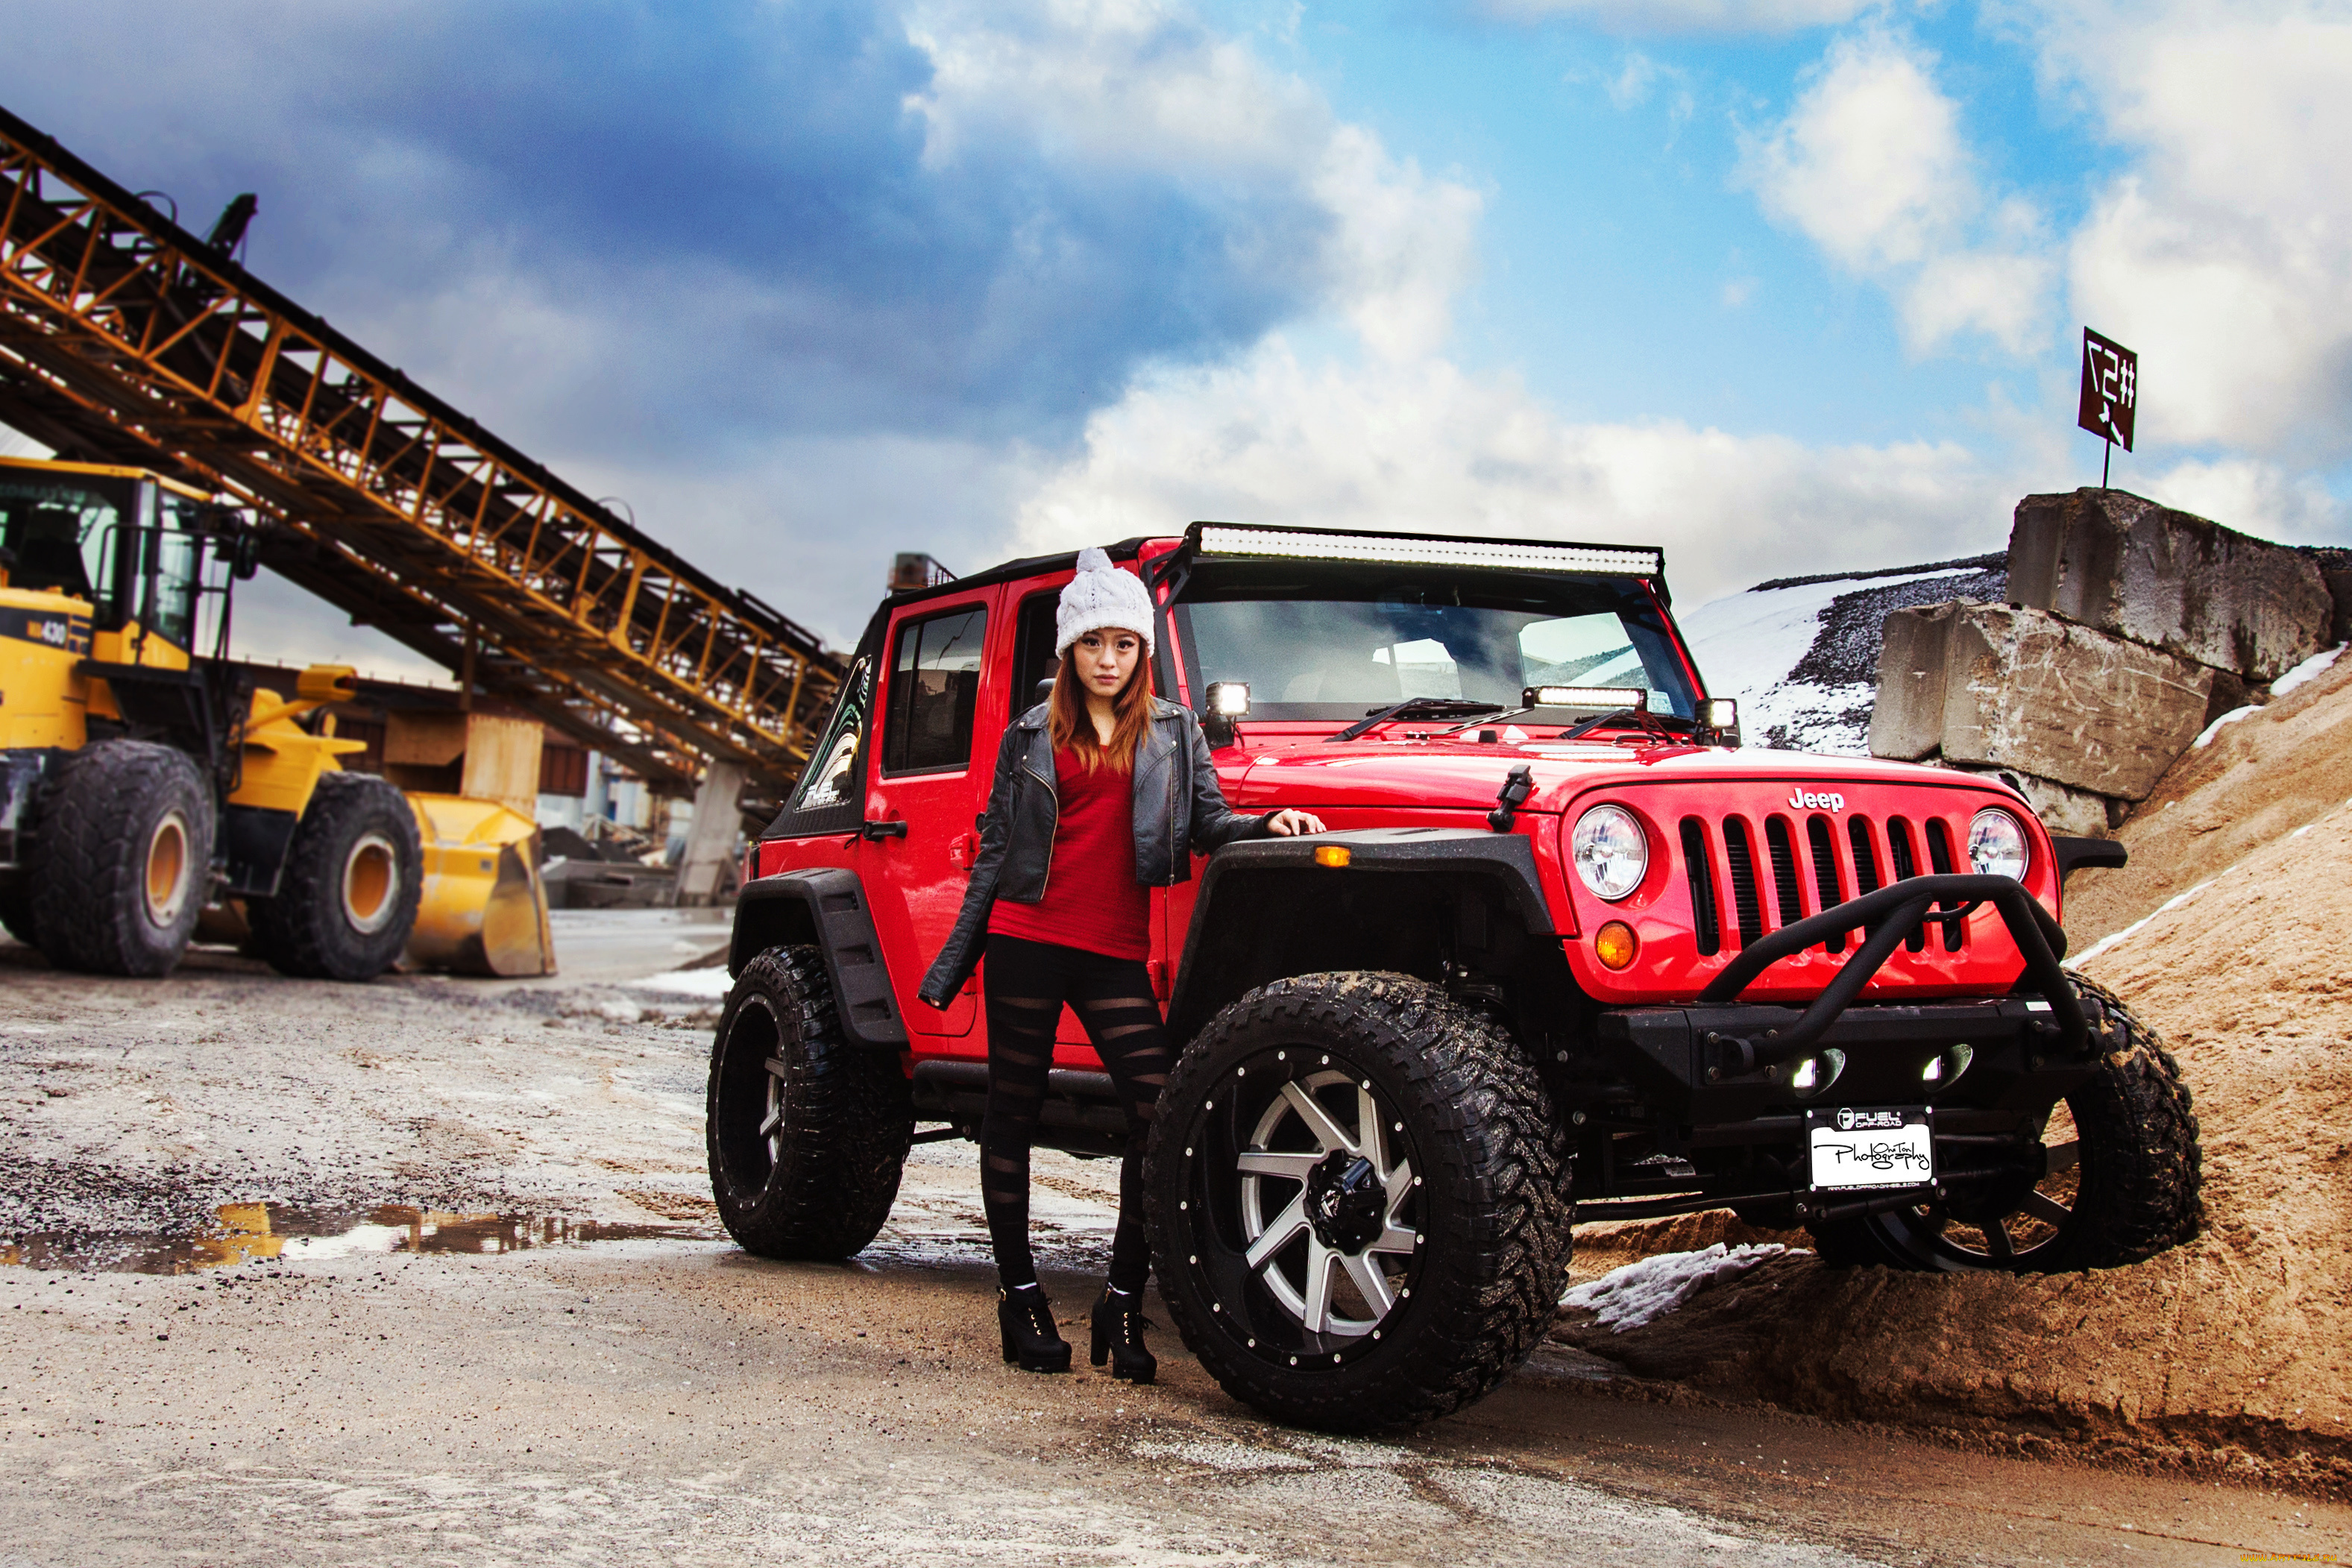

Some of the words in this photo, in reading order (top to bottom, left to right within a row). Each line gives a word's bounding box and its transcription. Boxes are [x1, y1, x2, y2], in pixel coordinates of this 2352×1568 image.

[805, 780, 840, 802] FUEL
[1788, 787, 1845, 813] Jeep
[1855, 1111, 1900, 1122] FUEL
[1855, 1120, 1902, 1128] OFF-ROAD
[1813, 1142, 1930, 1171] Photography
